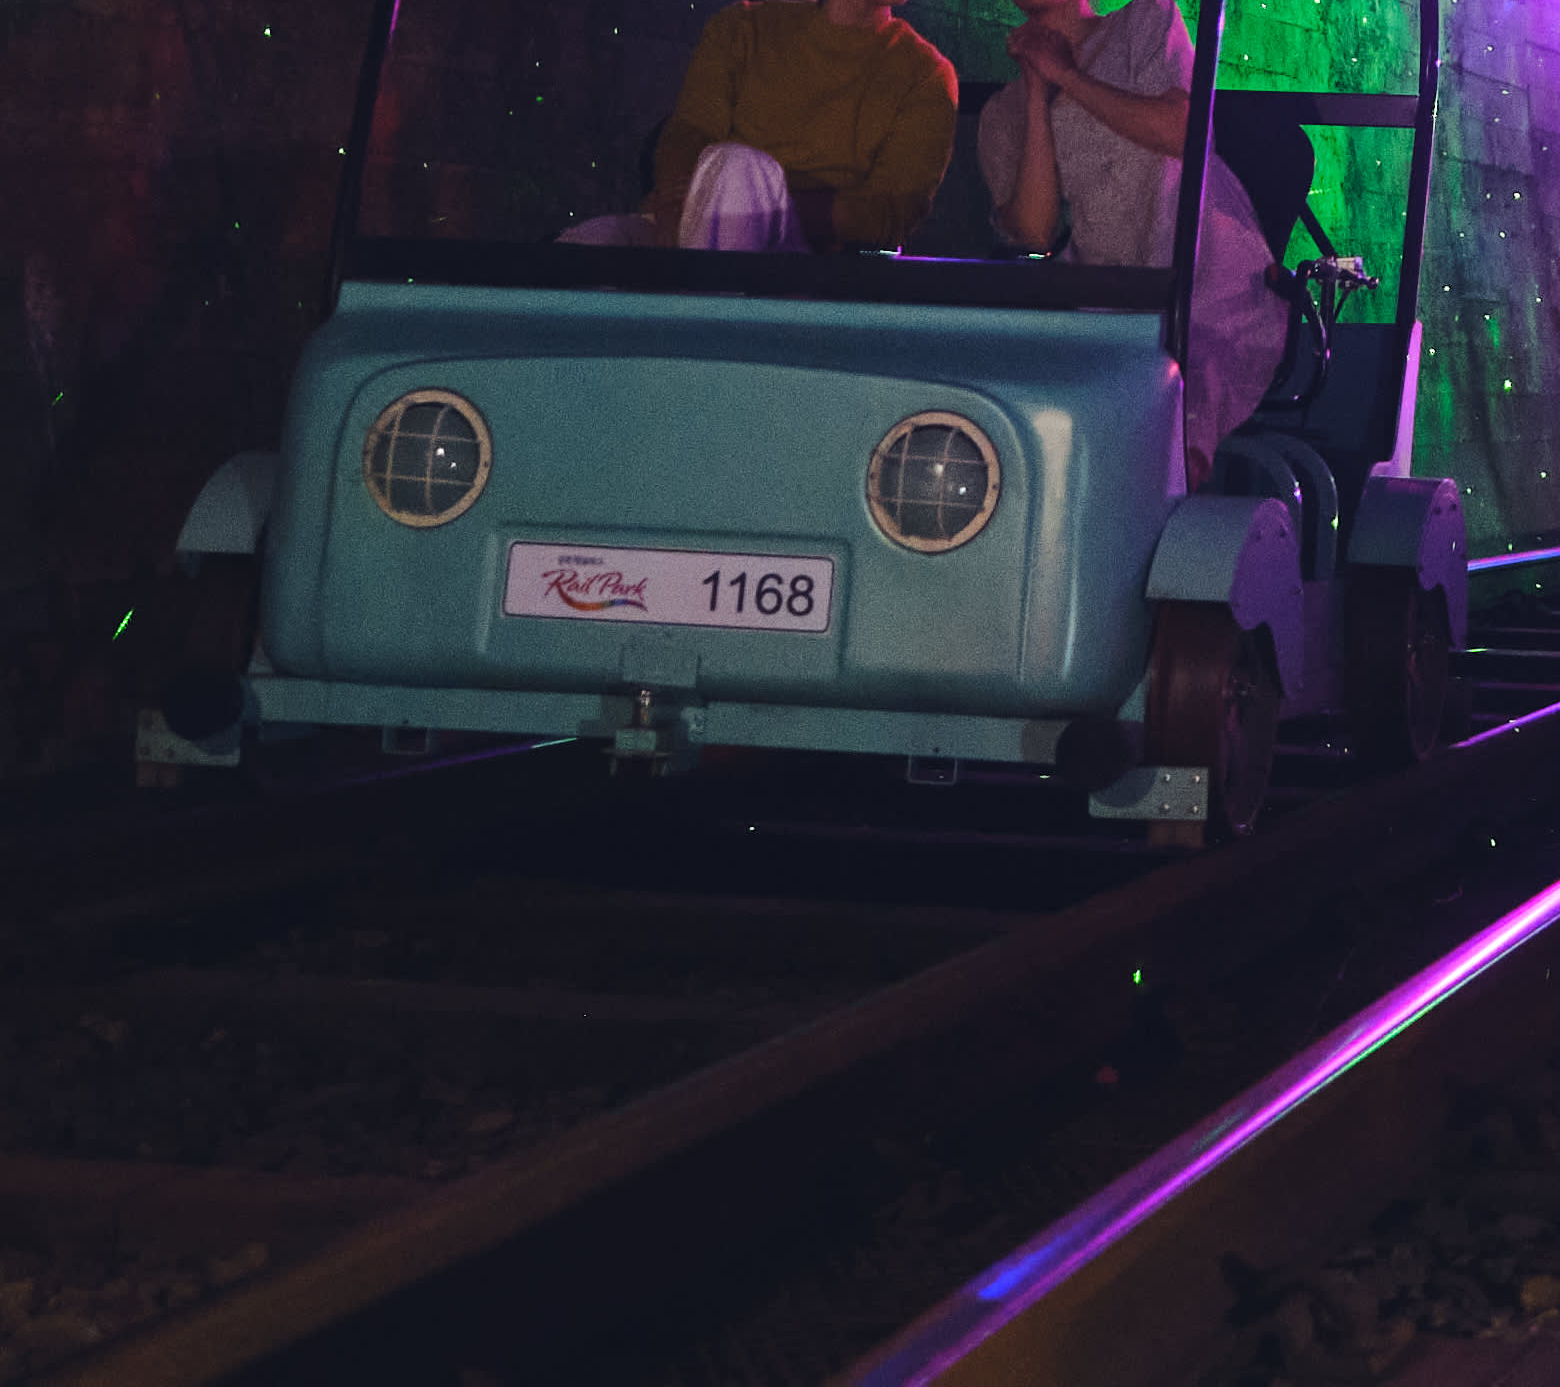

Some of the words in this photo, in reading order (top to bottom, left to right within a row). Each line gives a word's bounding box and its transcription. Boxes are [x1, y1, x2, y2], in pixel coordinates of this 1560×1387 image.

[541, 569, 600, 598] Rail
[598, 572, 648, 602] Park
[702, 570, 815, 616] 1168
